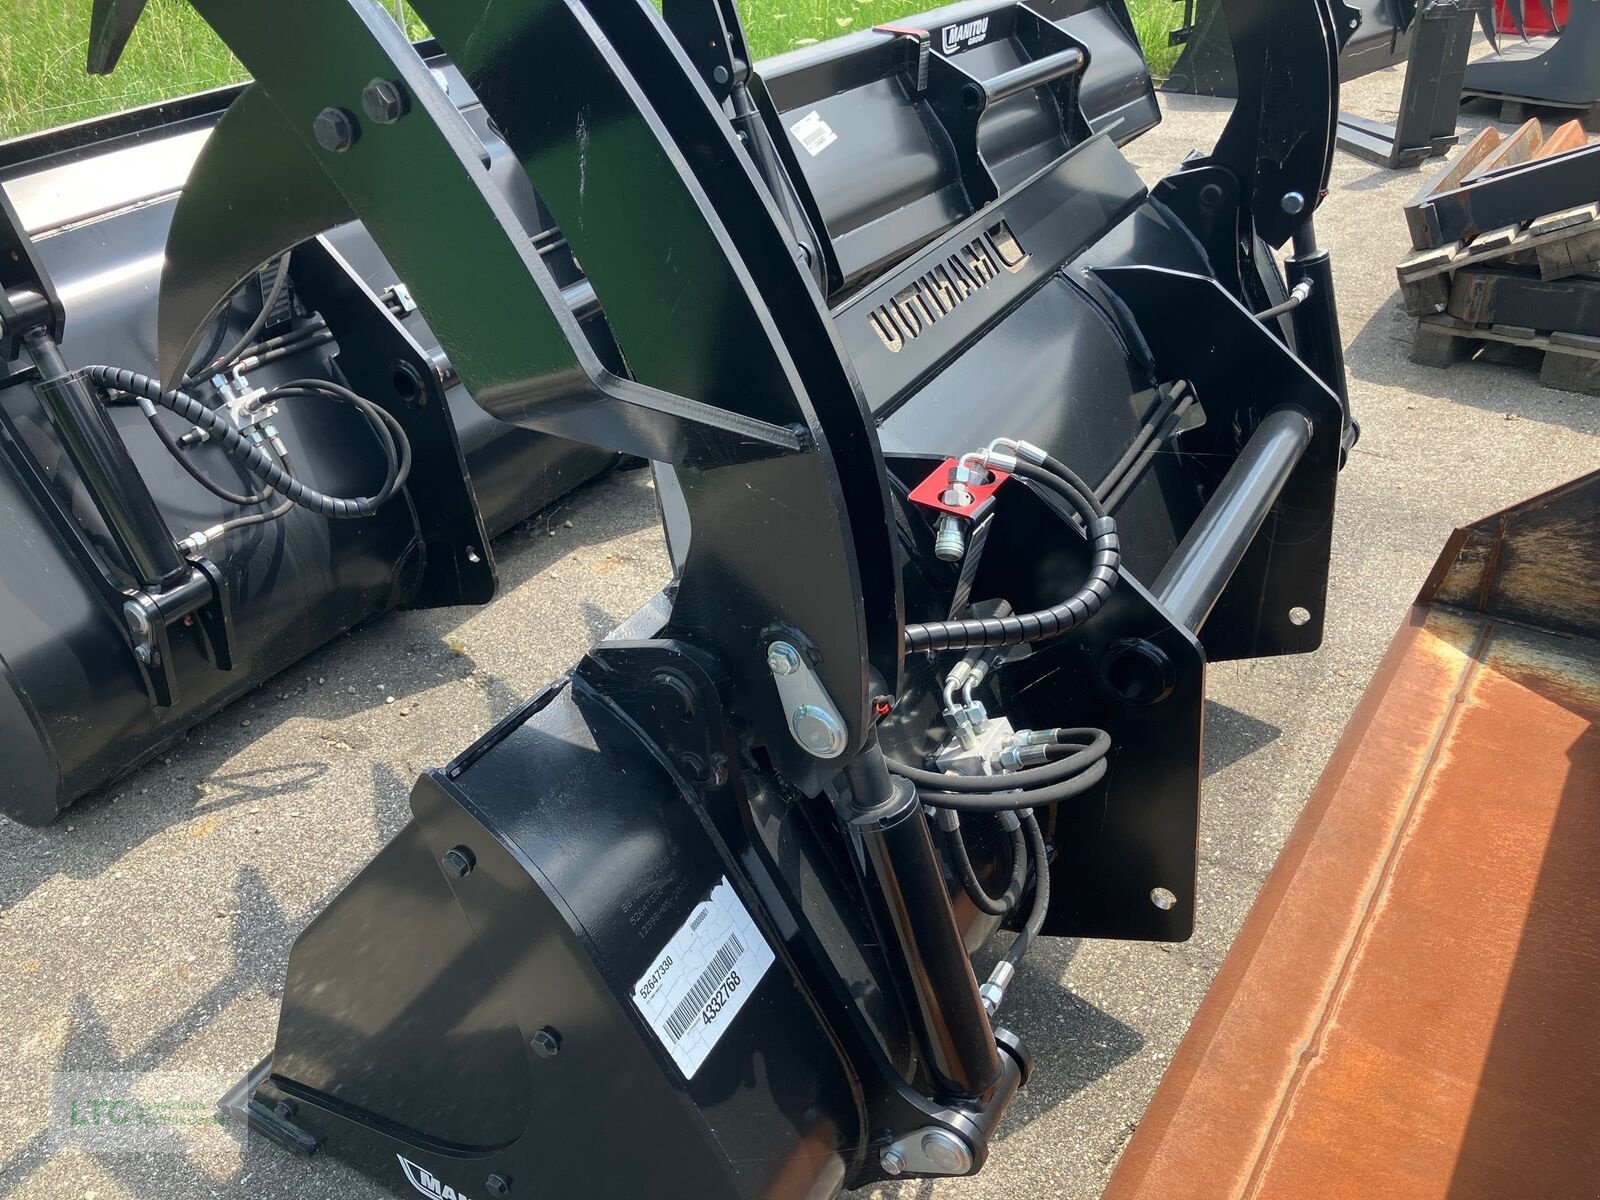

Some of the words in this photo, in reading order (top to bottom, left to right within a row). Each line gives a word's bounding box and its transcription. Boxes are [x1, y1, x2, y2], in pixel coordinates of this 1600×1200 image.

[950, 17, 989, 44] MANITOU
[968, 34, 986, 46] GROUP
[639, 955, 674, 1000] 52647330
[702, 970, 741, 1026] 4332768
